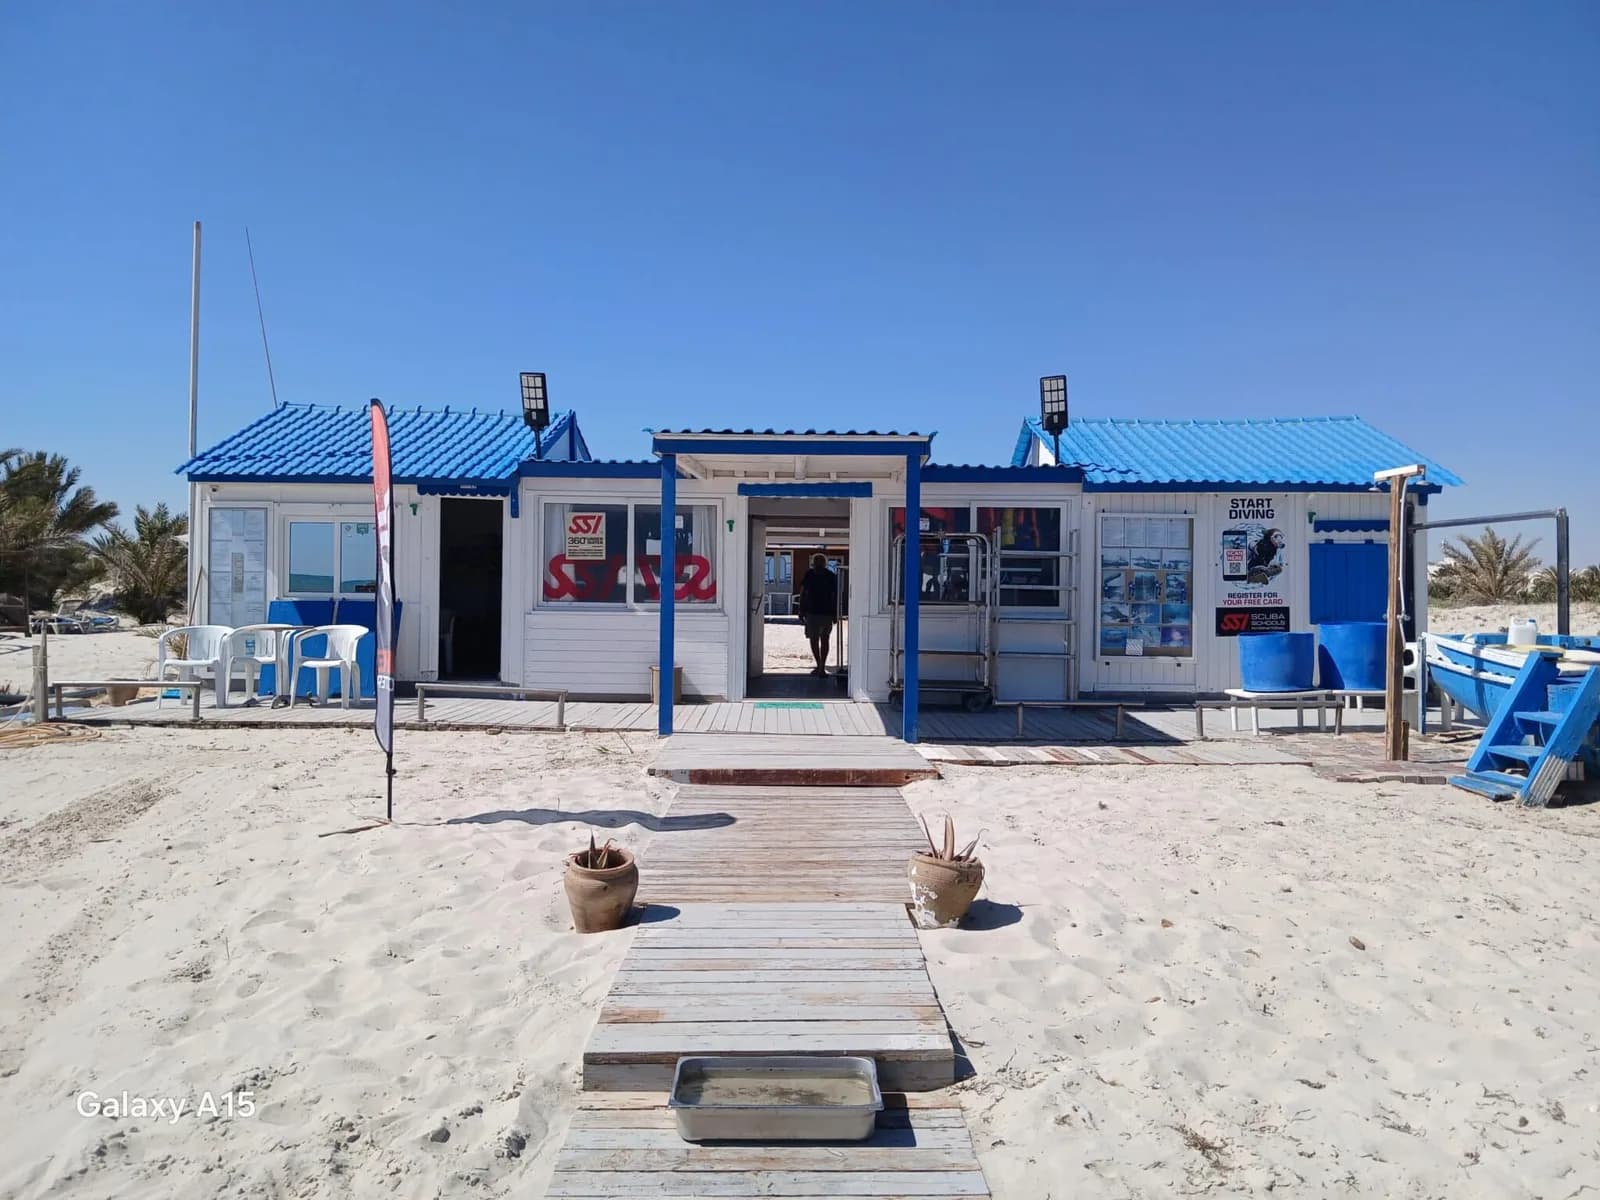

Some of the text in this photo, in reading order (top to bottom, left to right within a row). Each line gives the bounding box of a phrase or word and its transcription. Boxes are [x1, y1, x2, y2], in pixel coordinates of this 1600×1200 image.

[1230, 498, 1273, 508] START
[1229, 509, 1275, 520] DIVING
[569, 515, 603, 534] SSI
[1220, 613, 1249, 631] SSI
